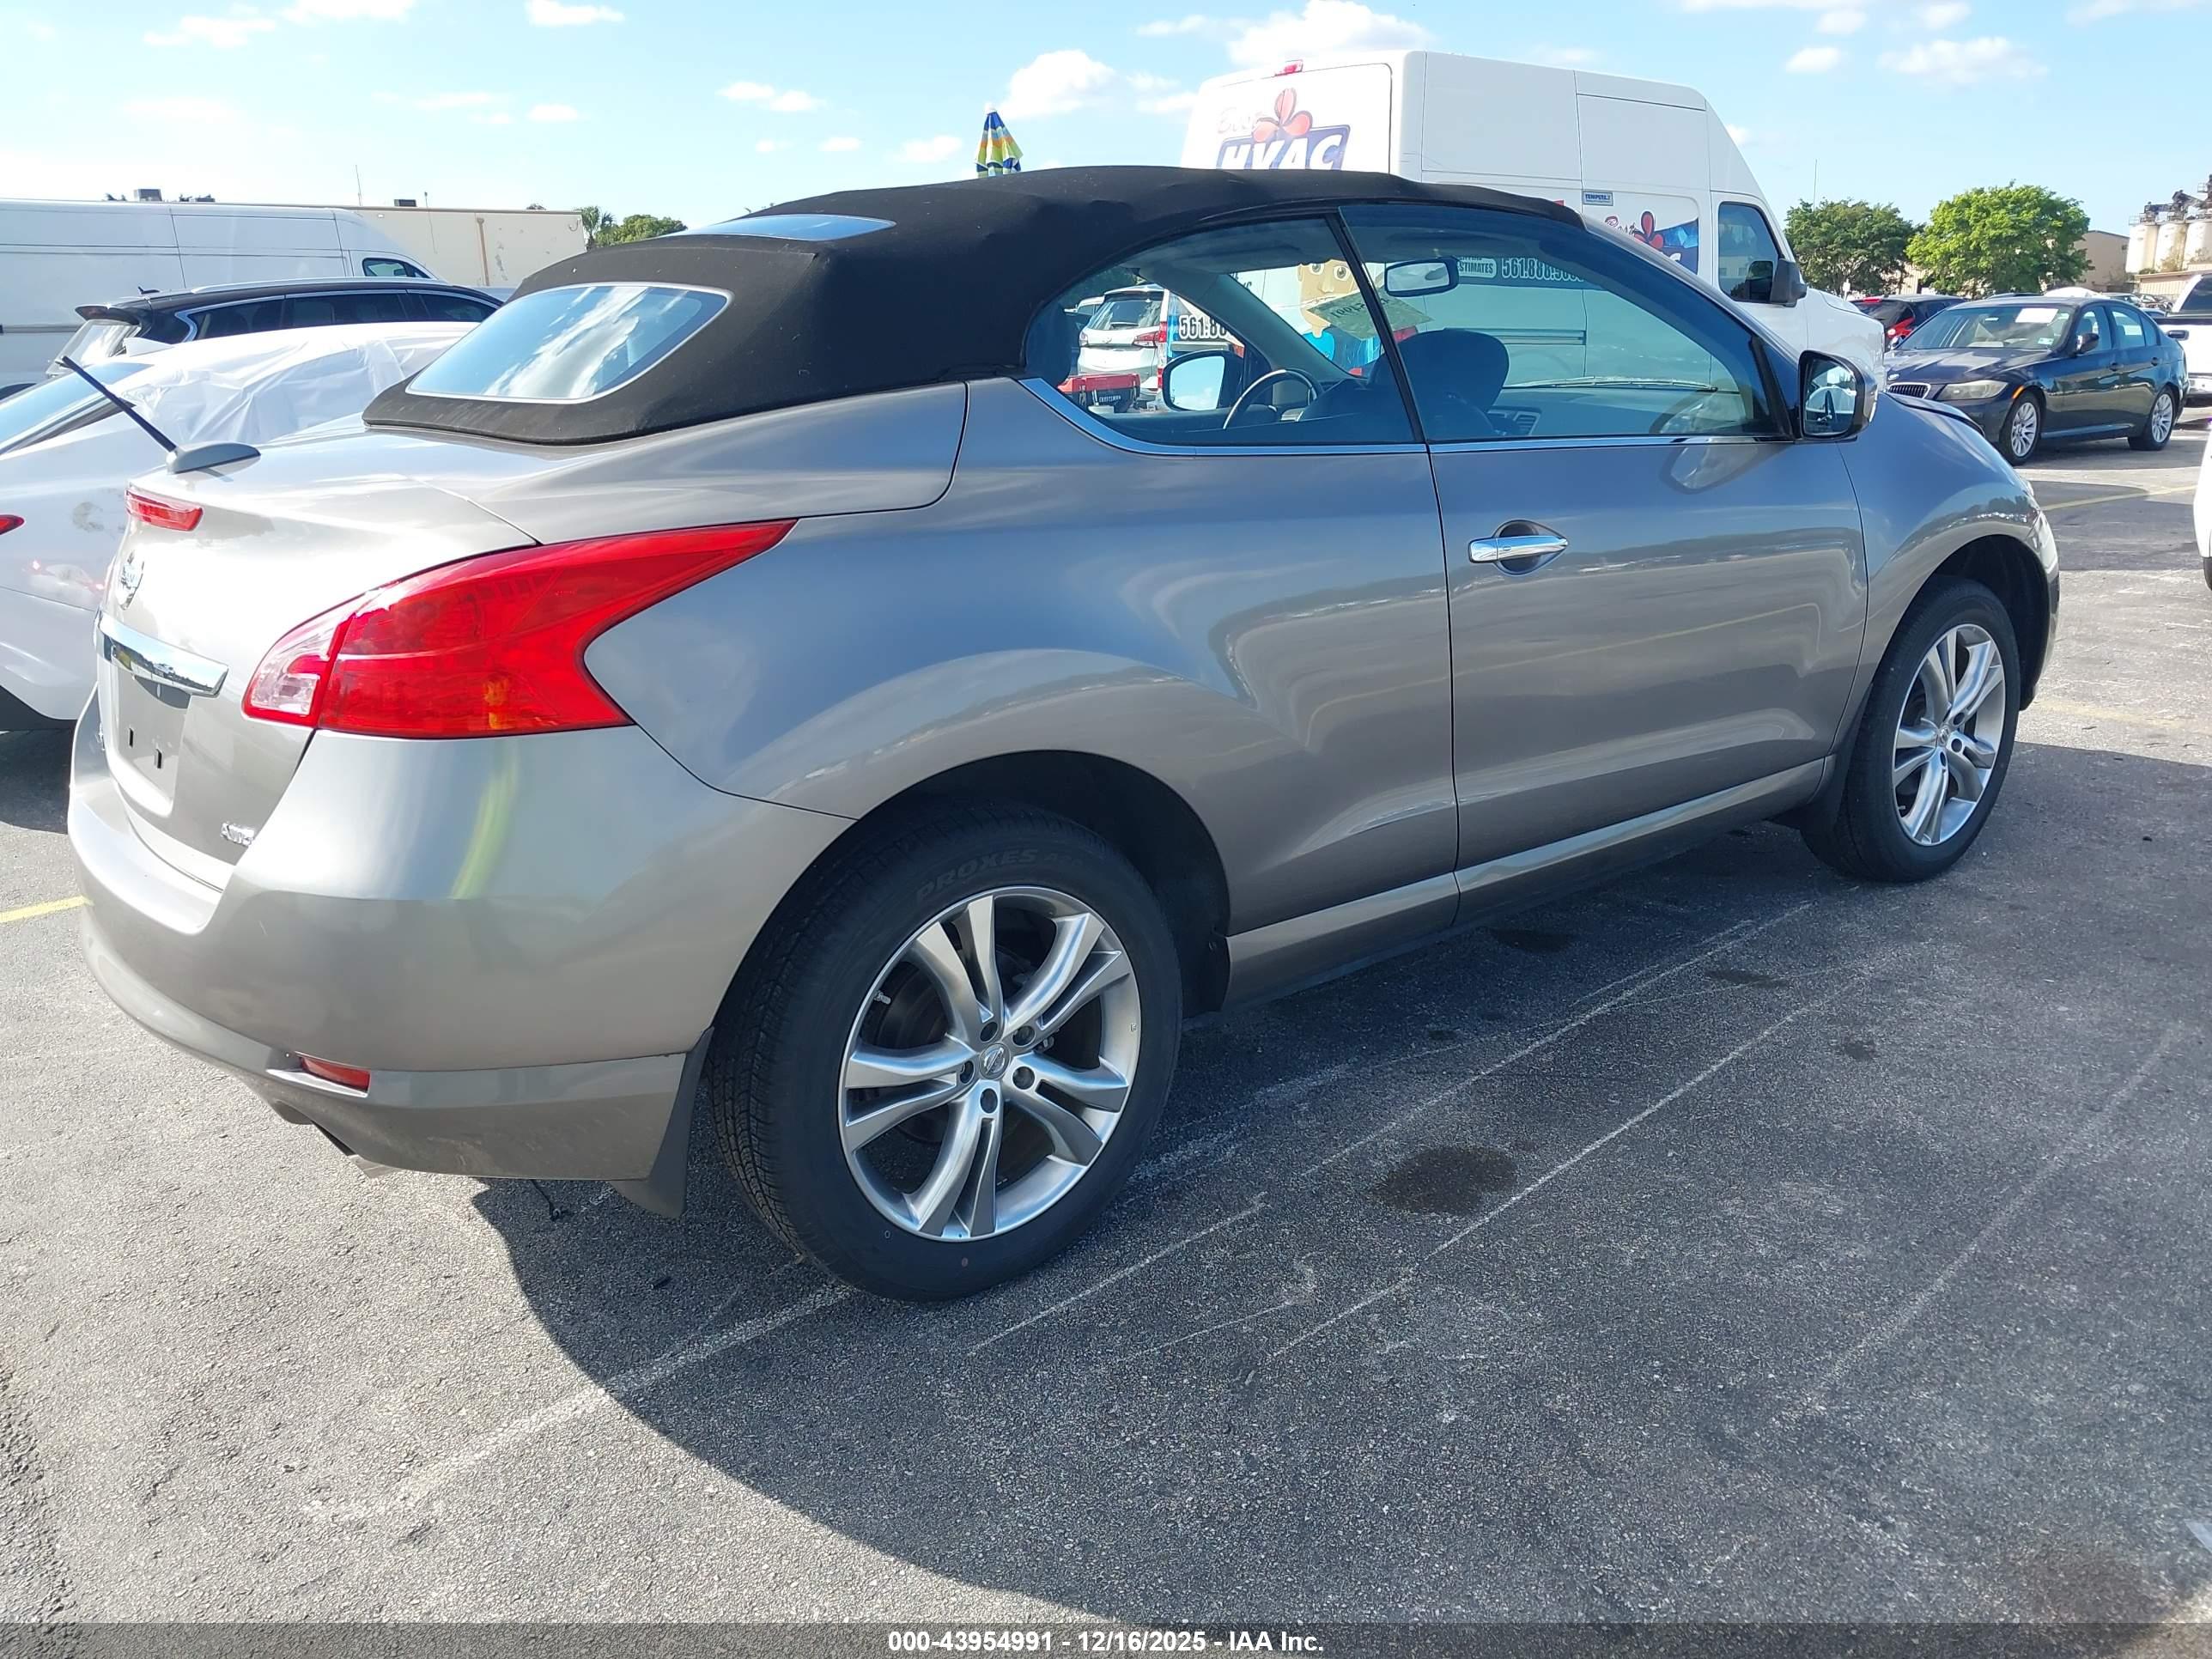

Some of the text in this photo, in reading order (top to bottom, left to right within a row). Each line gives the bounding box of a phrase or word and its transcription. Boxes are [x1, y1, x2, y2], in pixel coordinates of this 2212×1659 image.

[1221, 134, 1343, 170] HVAC
[1458, 262, 1493, 274] STIMATES
[916, 848, 1039, 902] PROXES
